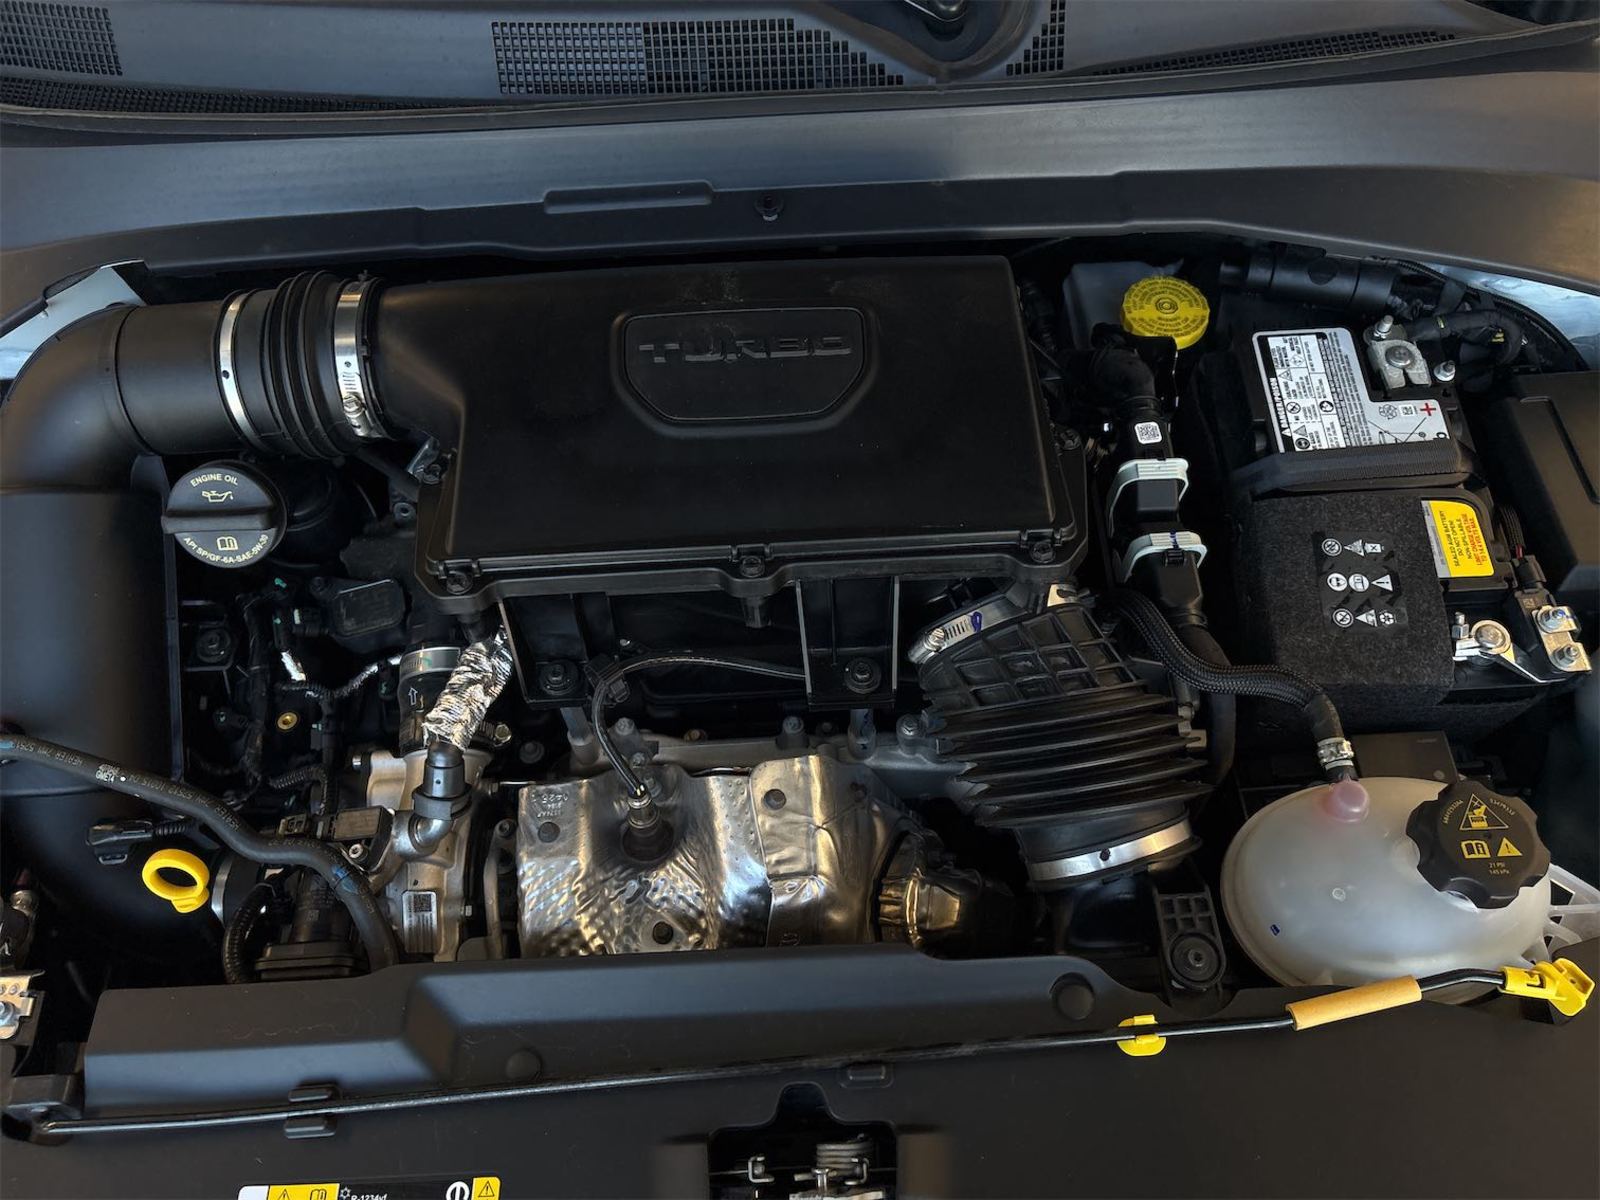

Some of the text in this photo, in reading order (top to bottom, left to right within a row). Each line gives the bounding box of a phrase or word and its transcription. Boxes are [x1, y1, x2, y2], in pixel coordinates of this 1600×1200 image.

[639, 337, 852, 363] TURBO
[1270, 376, 1289, 430] DANGER/POISON
[190, 473, 239, 487] ENGINE OIL
[183, 537, 198, 550] API
[1439, 510, 1460, 567] SEALED AGM BATTERY
[1453, 537, 1461, 547] NOT
[1457, 547, 1463, 556] DO
